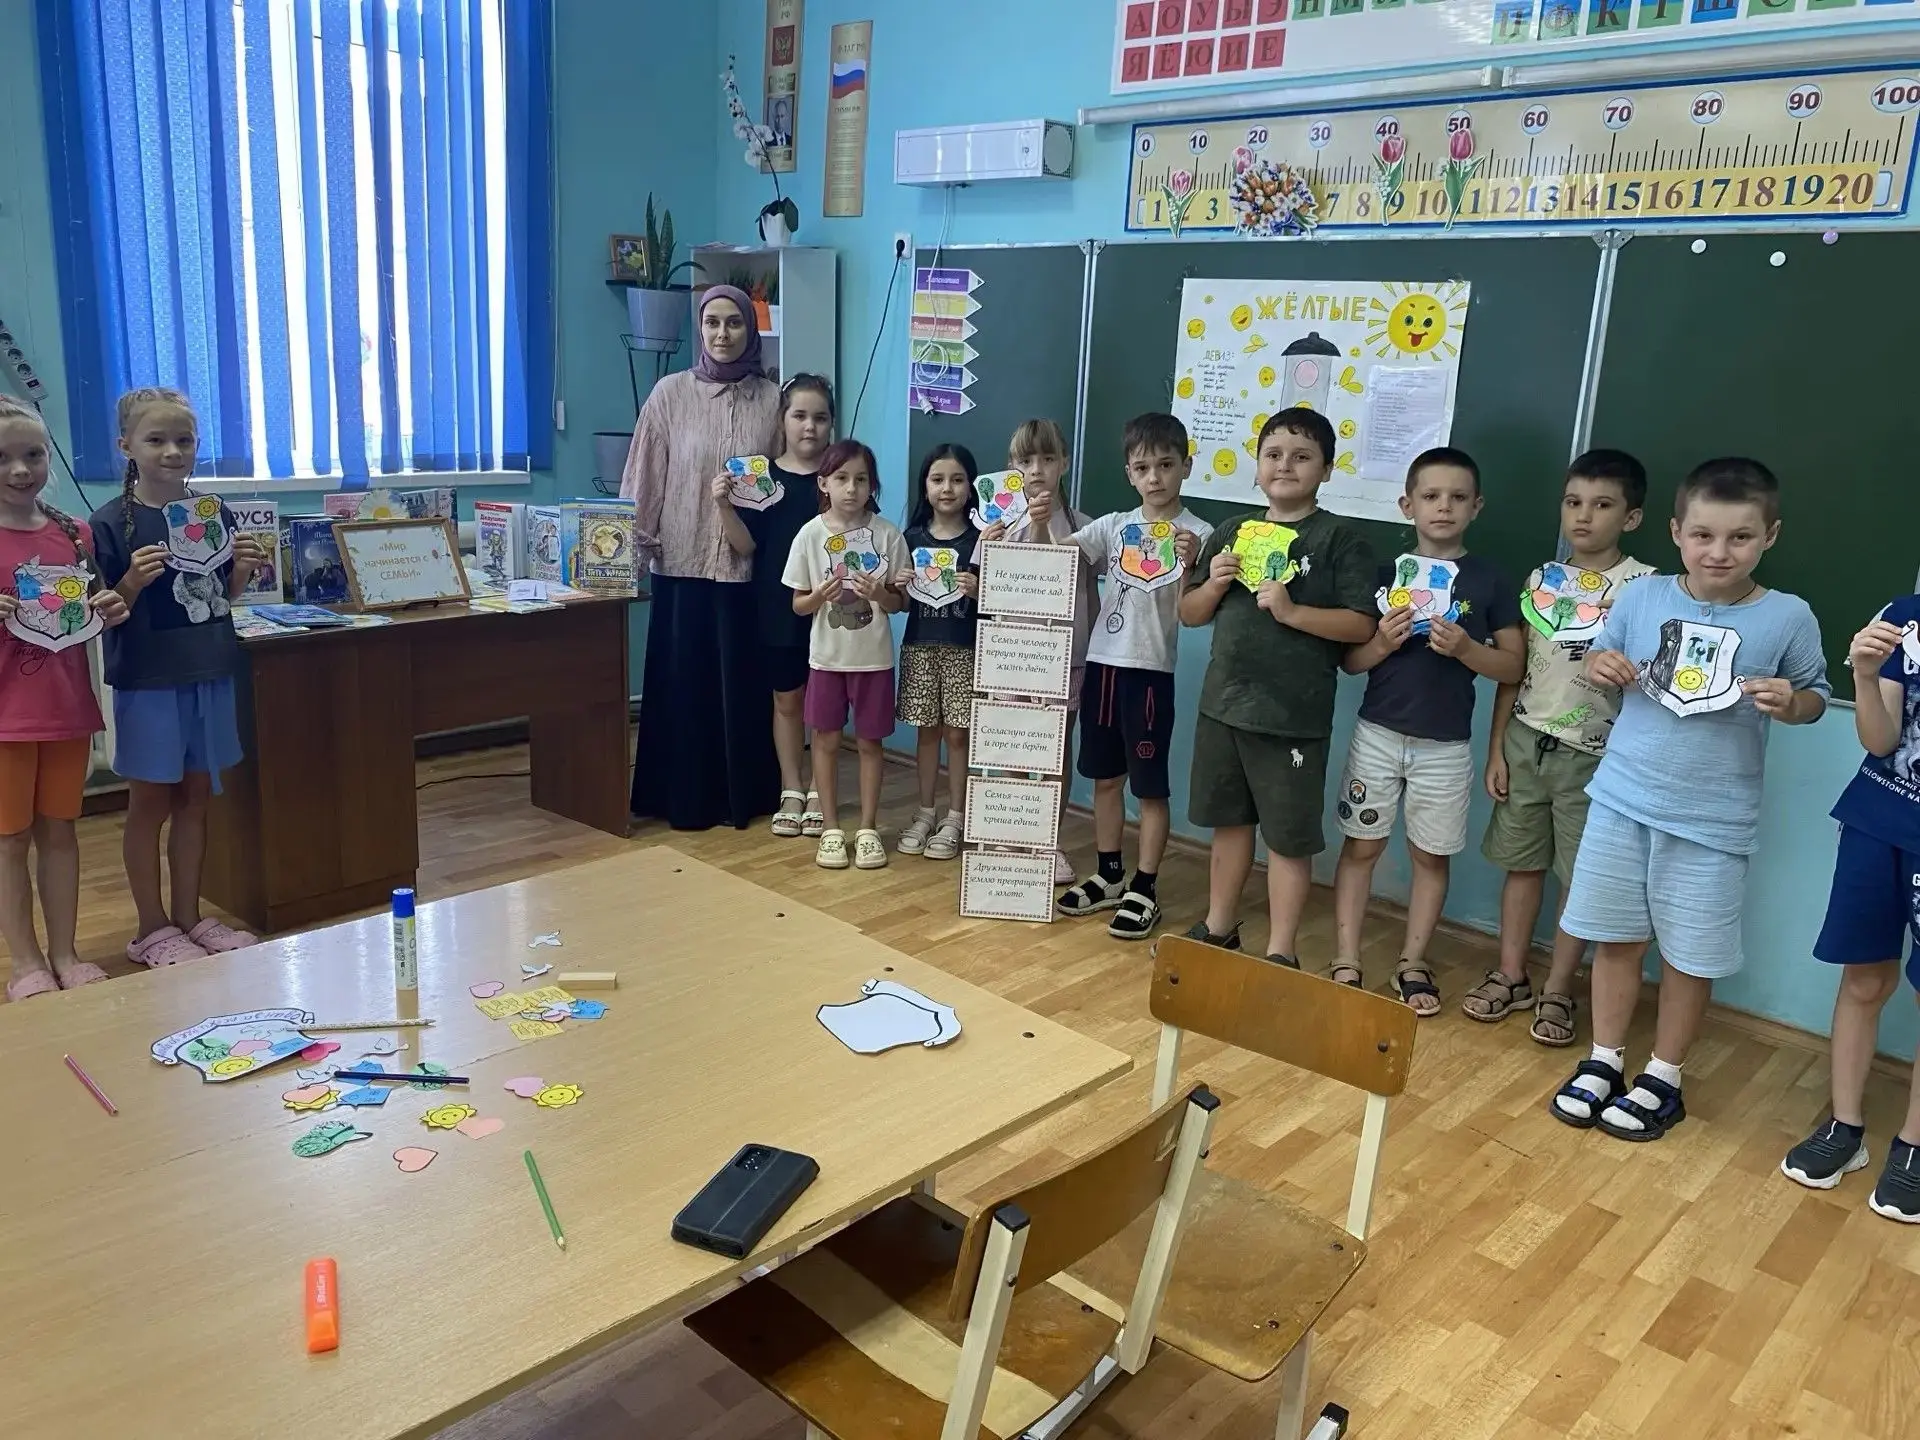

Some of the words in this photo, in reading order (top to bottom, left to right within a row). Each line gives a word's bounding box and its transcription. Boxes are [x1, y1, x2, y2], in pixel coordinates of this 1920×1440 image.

[1128, 52, 1145, 76] Я
[1185, 44, 1214, 68] Ю
[1223, 41, 1244, 66] И
[1260, 36, 1278, 62] Е
[1141, 139, 1151, 153] 0
[1190, 134, 1208, 149] 10
[1248, 129, 1269, 145] 20
[1310, 126, 1331, 141] 30
[1376, 121, 1398, 138] 40
[1447, 116, 1471, 133] 50
[1523, 111, 1549, 128] 60
[1606, 105, 1632, 124] 70
[1692, 98, 1723, 117] 80
[1789, 91, 1820, 111] 90
[1873, 85, 1920, 106] 100
[1205, 196, 1220, 221] 3
[1326, 192, 1341, 218] 7
[1356, 190, 1371, 218] 8
[1417, 189, 1447, 216] 10
[1490, 186, 1520, 214] 12
[1525, 184, 1559, 213] 13
[1564, 183, 1599, 211] 14
[1605, 181, 1642, 211] 15
[1646, 179, 1684, 210] 16
[1690, 177, 1731, 209] 17
[1736, 175, 1776, 208] 18
[1784, 173, 1825, 206] 19
[1827, 171, 1874, 205] 20
[1256, 290, 1368, 322] ЖЁЛТЫЕ
[364, 557, 420, 568] начинается
[995, 570, 1008, 579] Не
[1009, 573, 1037, 582] нужен
[990, 584, 1013, 593] когда
[1021, 587, 1046, 596] семье
[991, 634, 1019, 645] Семья
[1021, 639, 1058, 649] человеку
[986, 649, 1016, 660] первую
[996, 663, 1023, 672] жизнь
[980, 725, 1026, 738] Согласную
[1027, 730, 1055, 740] семью
[991, 742, 1009, 750] горе
[1894, 776, 1917, 791] CANIS
[985, 789, 1012, 800] Семья
[985, 803, 1007, 813] когда
[1009, 805, 1023, 814] над
[1025, 807, 1040, 815] ней
[983, 816, 1012, 826] крыша
[974, 863, 1012, 874] Дружная
[1014, 866, 1039, 875] семья
[970, 876, 995, 884] землю
[997, 877, 1047, 888] превращает
